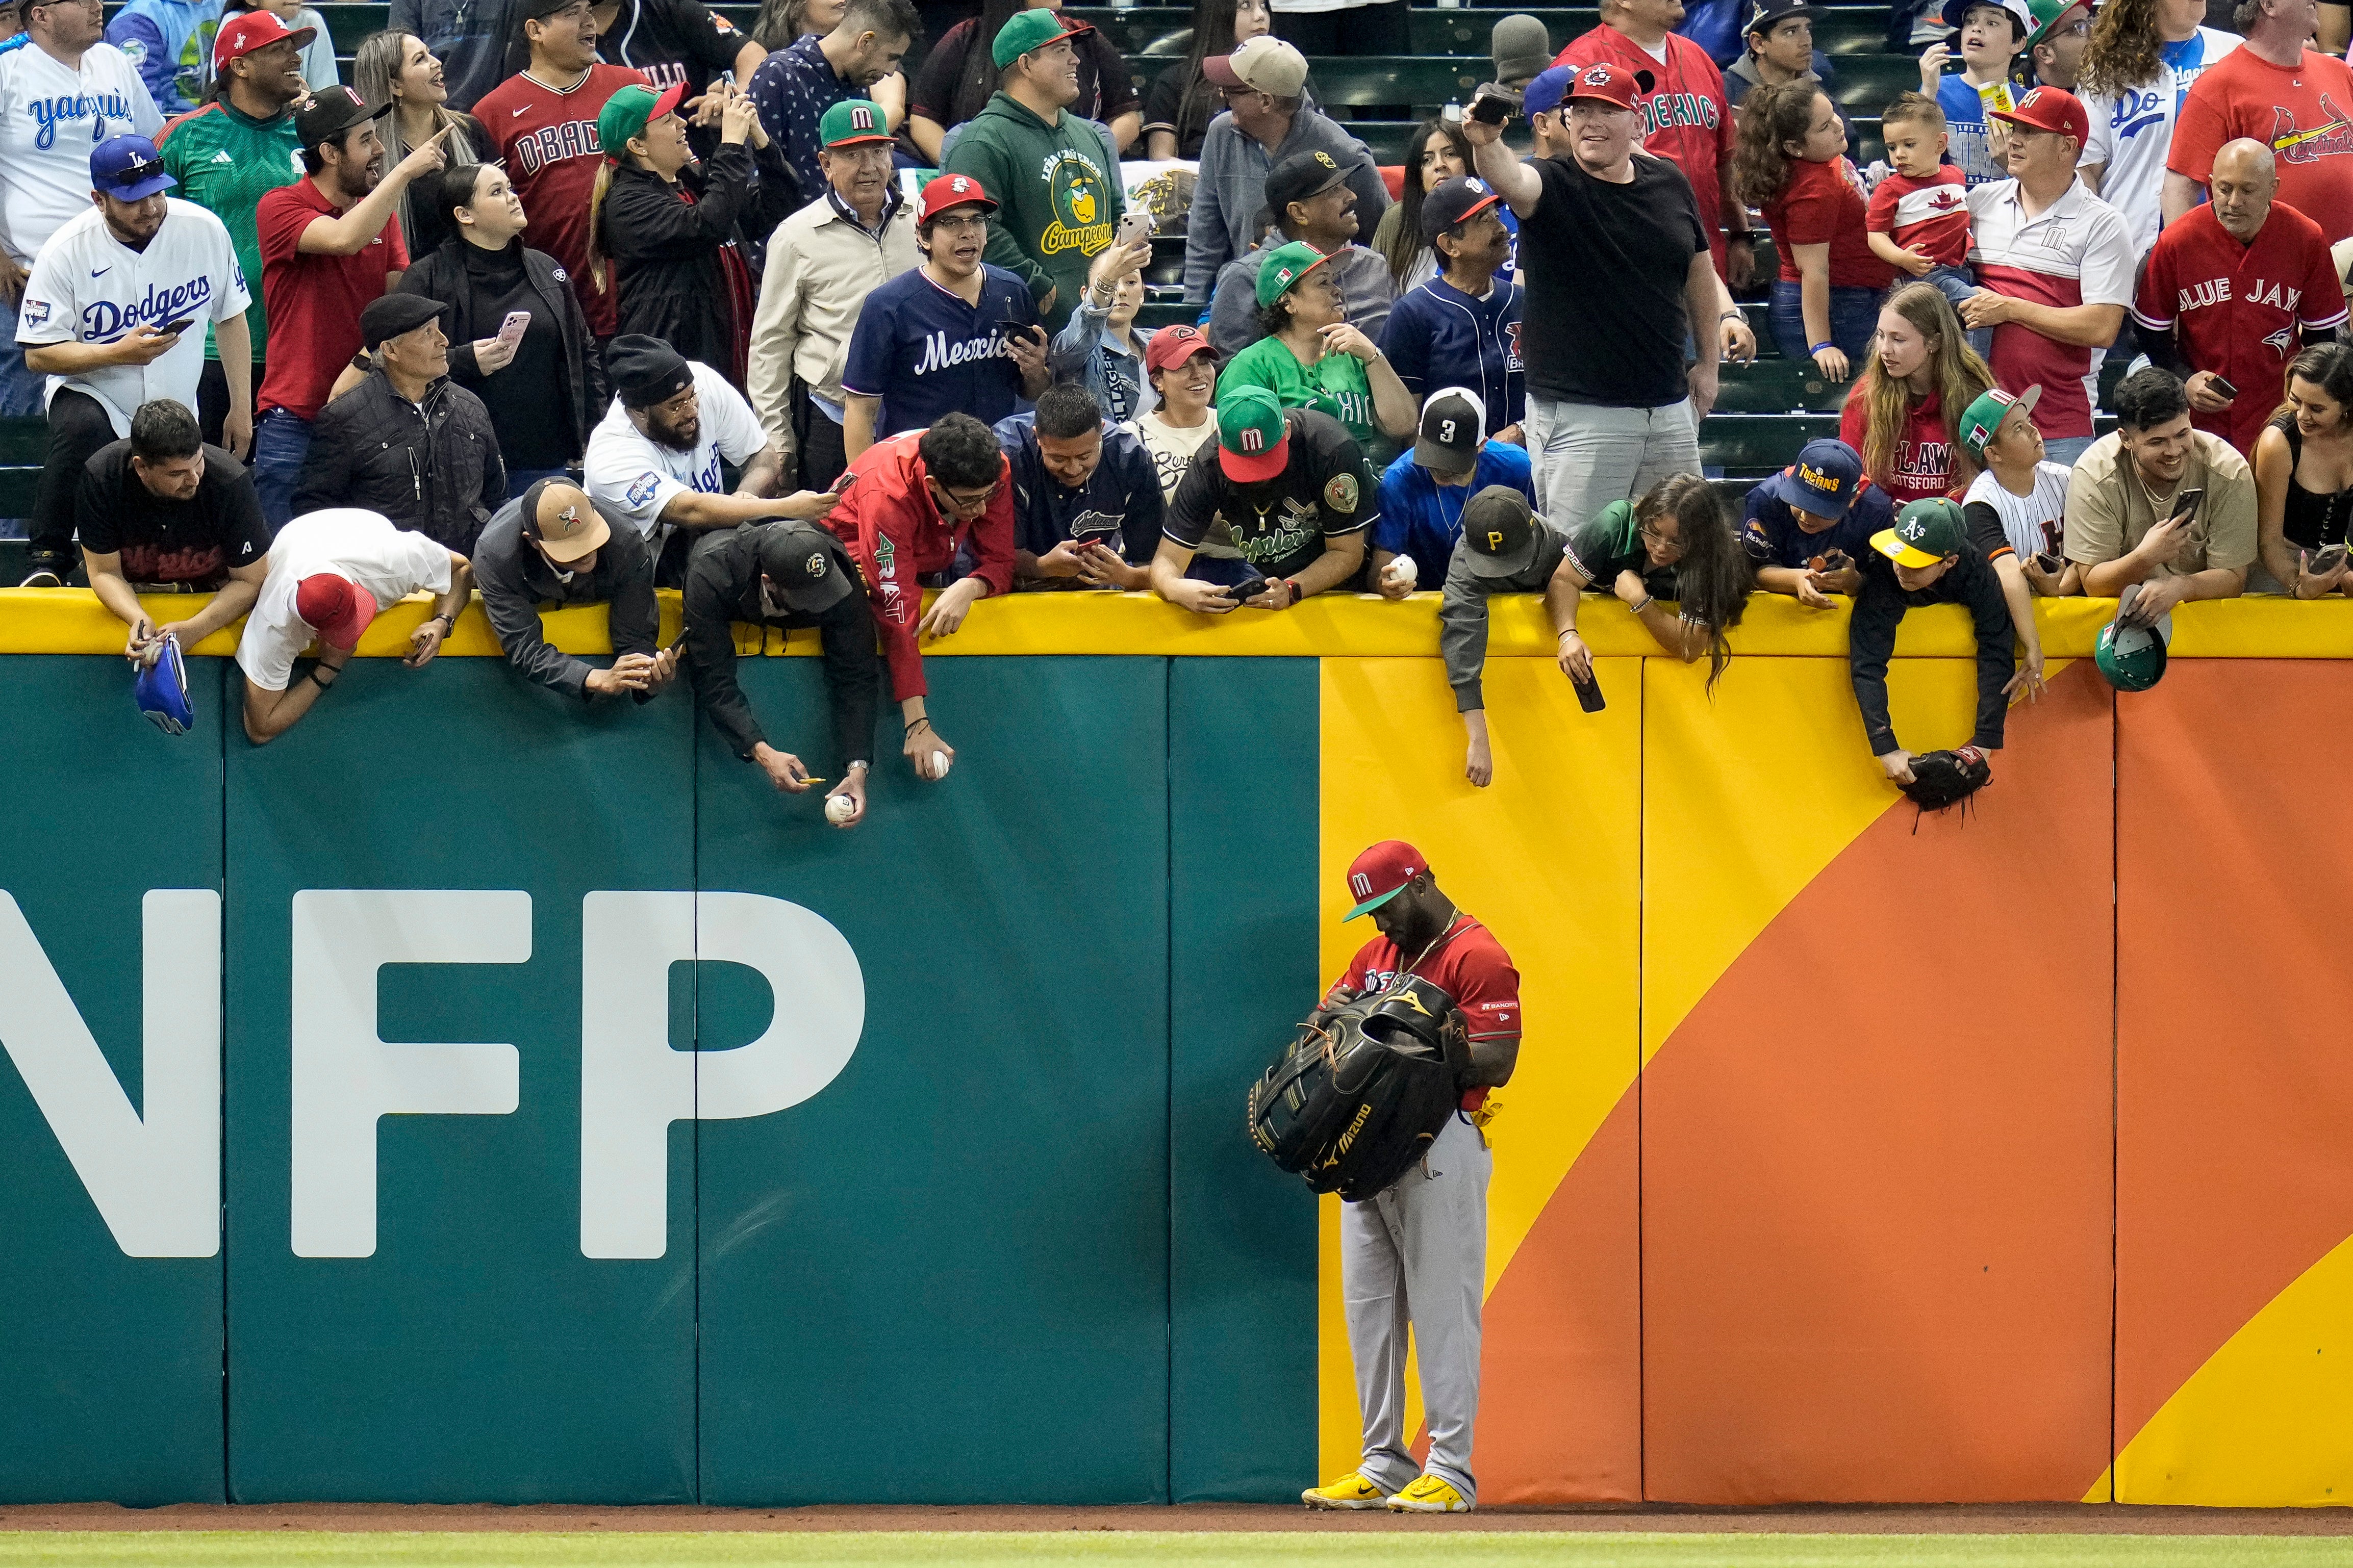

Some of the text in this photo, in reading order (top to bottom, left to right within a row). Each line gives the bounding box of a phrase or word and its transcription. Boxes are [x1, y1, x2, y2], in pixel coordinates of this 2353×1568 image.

[83, 275, 211, 341] Dodgers
[2245, 278, 2303, 312] JAY
[1439, 419, 1456, 444] 3
[1799, 462, 1839, 492] TUCANS
[1487, 531, 1503, 551] P
[873, 531, 905, 624] ARIAT
[0, 889, 866, 1258] NFP
[1338, 1103, 1371, 1155] MIZUNO
